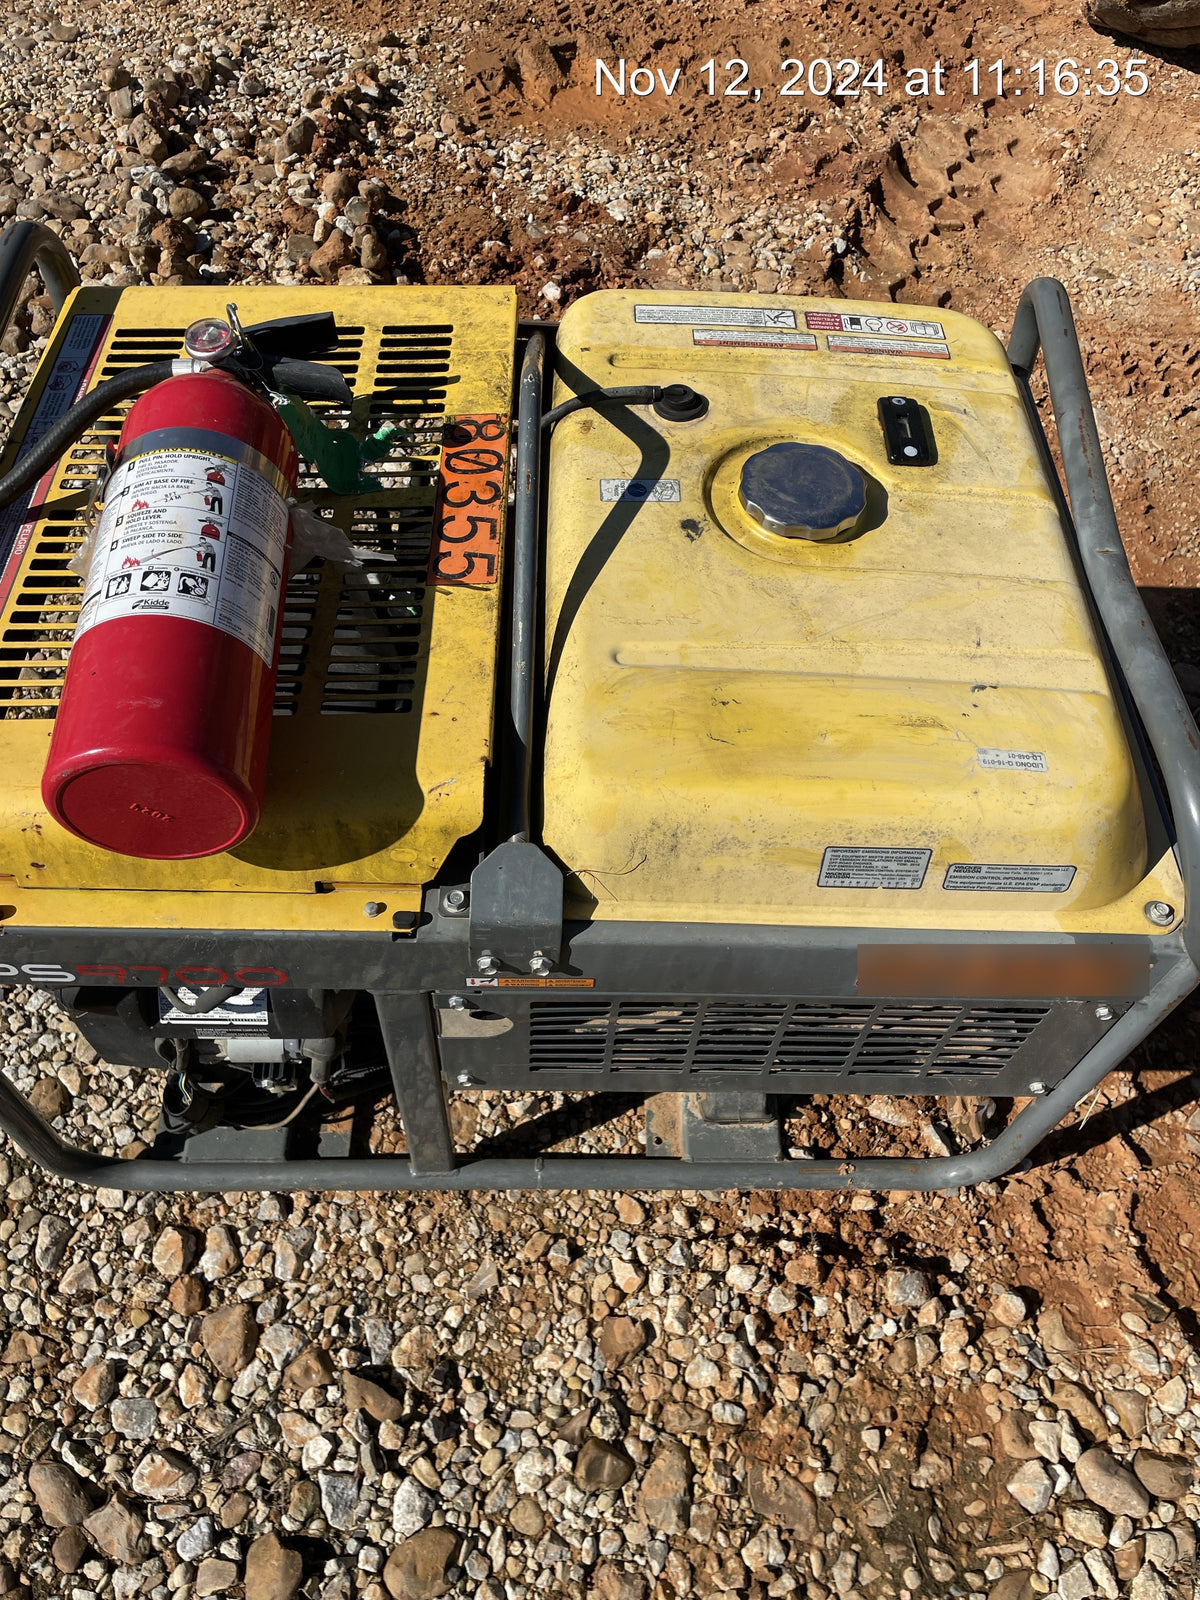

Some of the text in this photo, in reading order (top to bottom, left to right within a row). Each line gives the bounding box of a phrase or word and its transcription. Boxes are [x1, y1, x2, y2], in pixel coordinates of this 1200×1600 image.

[719, 340, 784, 348] AVERTISSEMENT
[432, 418, 506, 580] 80355
[126, 509, 151, 519] SQUEEZE
[14, 524, 33, 555] PELIGRO
[122, 535, 141, 543] SWEEP
[1015, 760, 1044, 768] LIDONG
